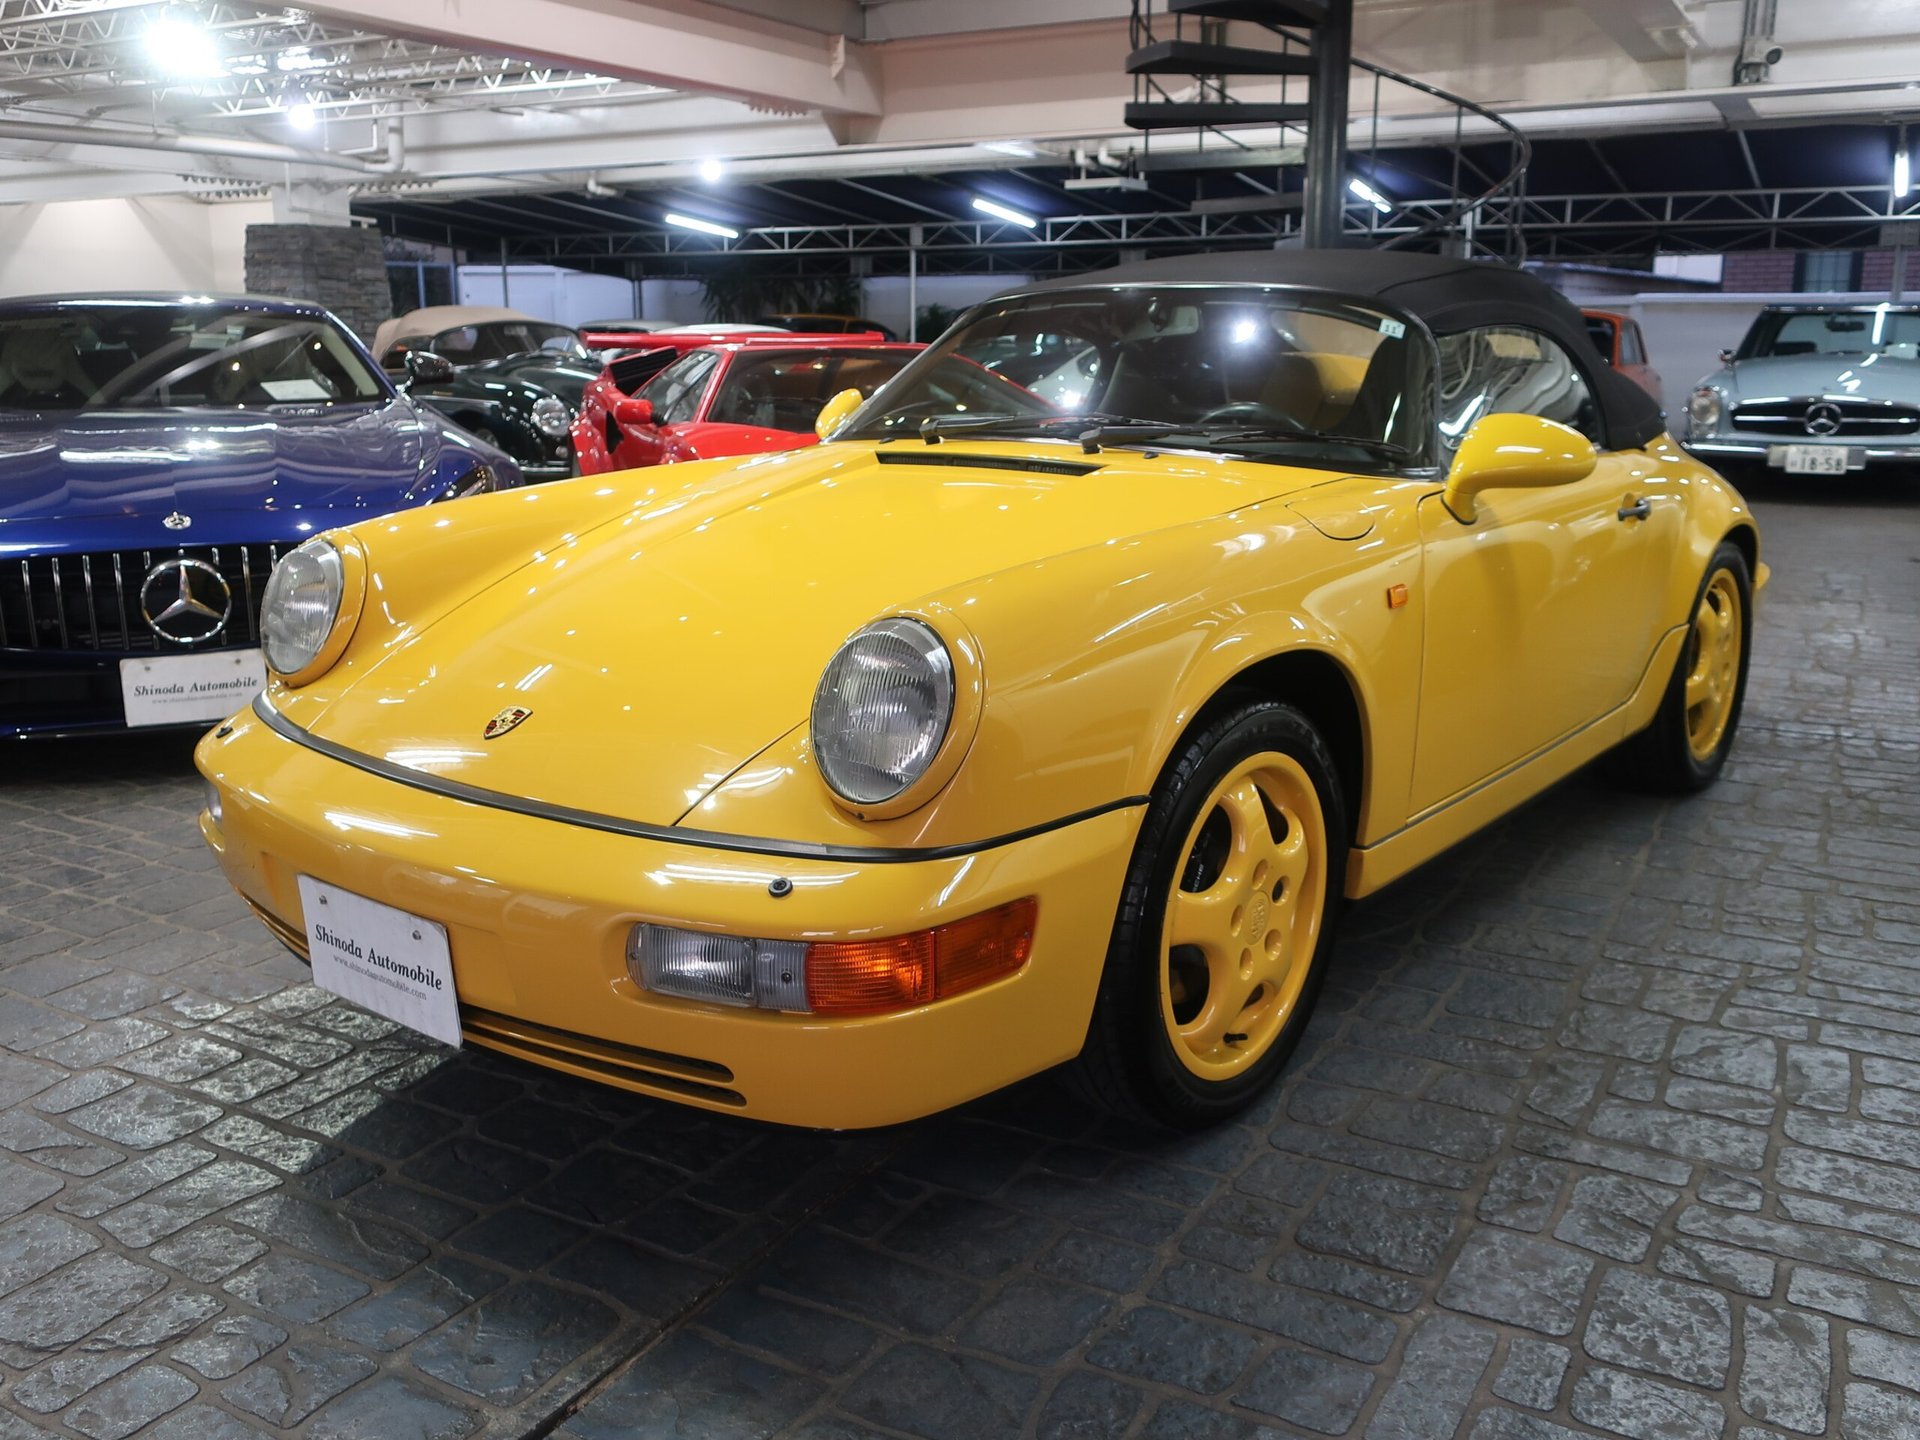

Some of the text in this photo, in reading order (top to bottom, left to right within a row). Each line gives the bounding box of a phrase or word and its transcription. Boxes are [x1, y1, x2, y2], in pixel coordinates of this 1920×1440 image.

[134, 677, 258, 697] Shinoda Automobile
[315, 923, 443, 991] Shinoda Automobile
